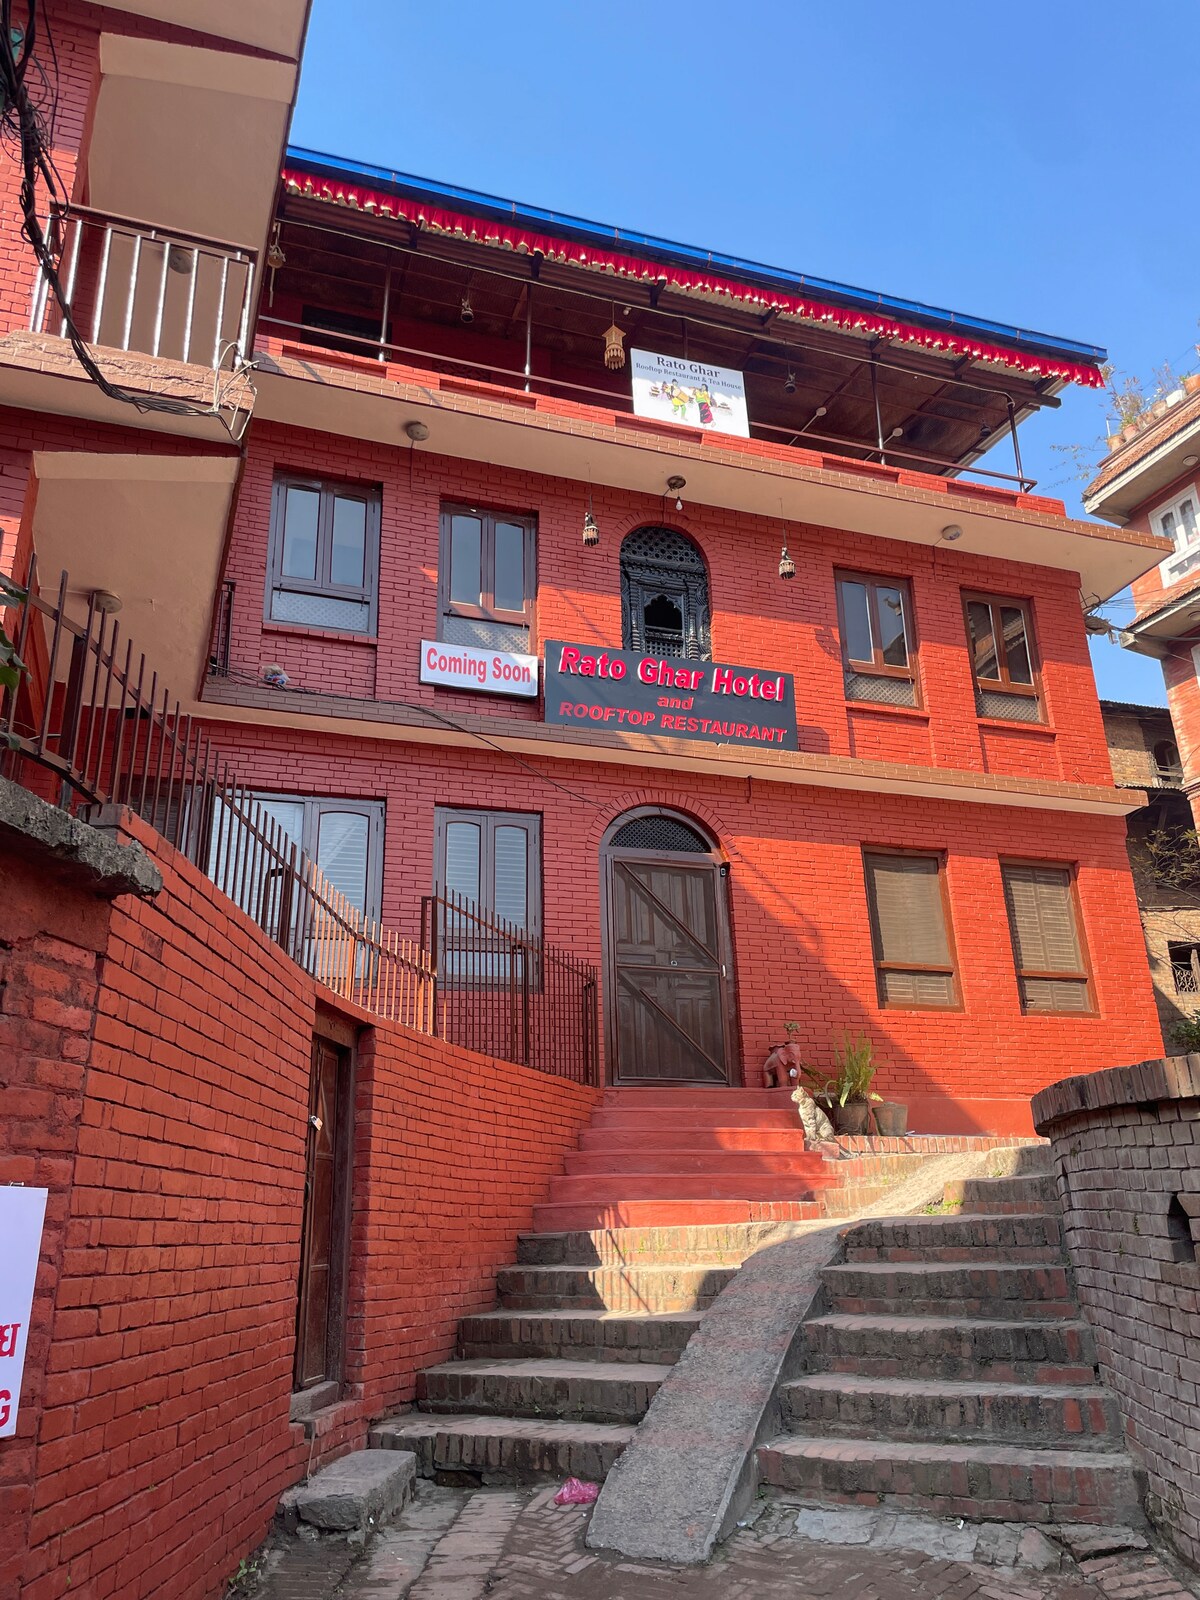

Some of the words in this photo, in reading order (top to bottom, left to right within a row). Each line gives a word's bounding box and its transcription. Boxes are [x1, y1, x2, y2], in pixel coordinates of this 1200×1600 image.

[635, 362, 663, 374] Rooftop
[663, 368, 701, 382] Restaurant
[708, 378, 720, 386] Tea
[721, 380, 742, 390] House
[656, 356, 686, 371] Rato
[689, 363, 721, 378] Ghar
[426, 647, 487, 683] Coming
[492, 656, 531, 683] Soon
[558, 645, 627, 680] Rato
[637, 657, 704, 691] Ghar
[711, 667, 785, 702] Hotel
[657, 695, 694, 710] and
[559, 701, 656, 726] ROOFTOP
[660, 713, 787, 743] RESTAURANT
